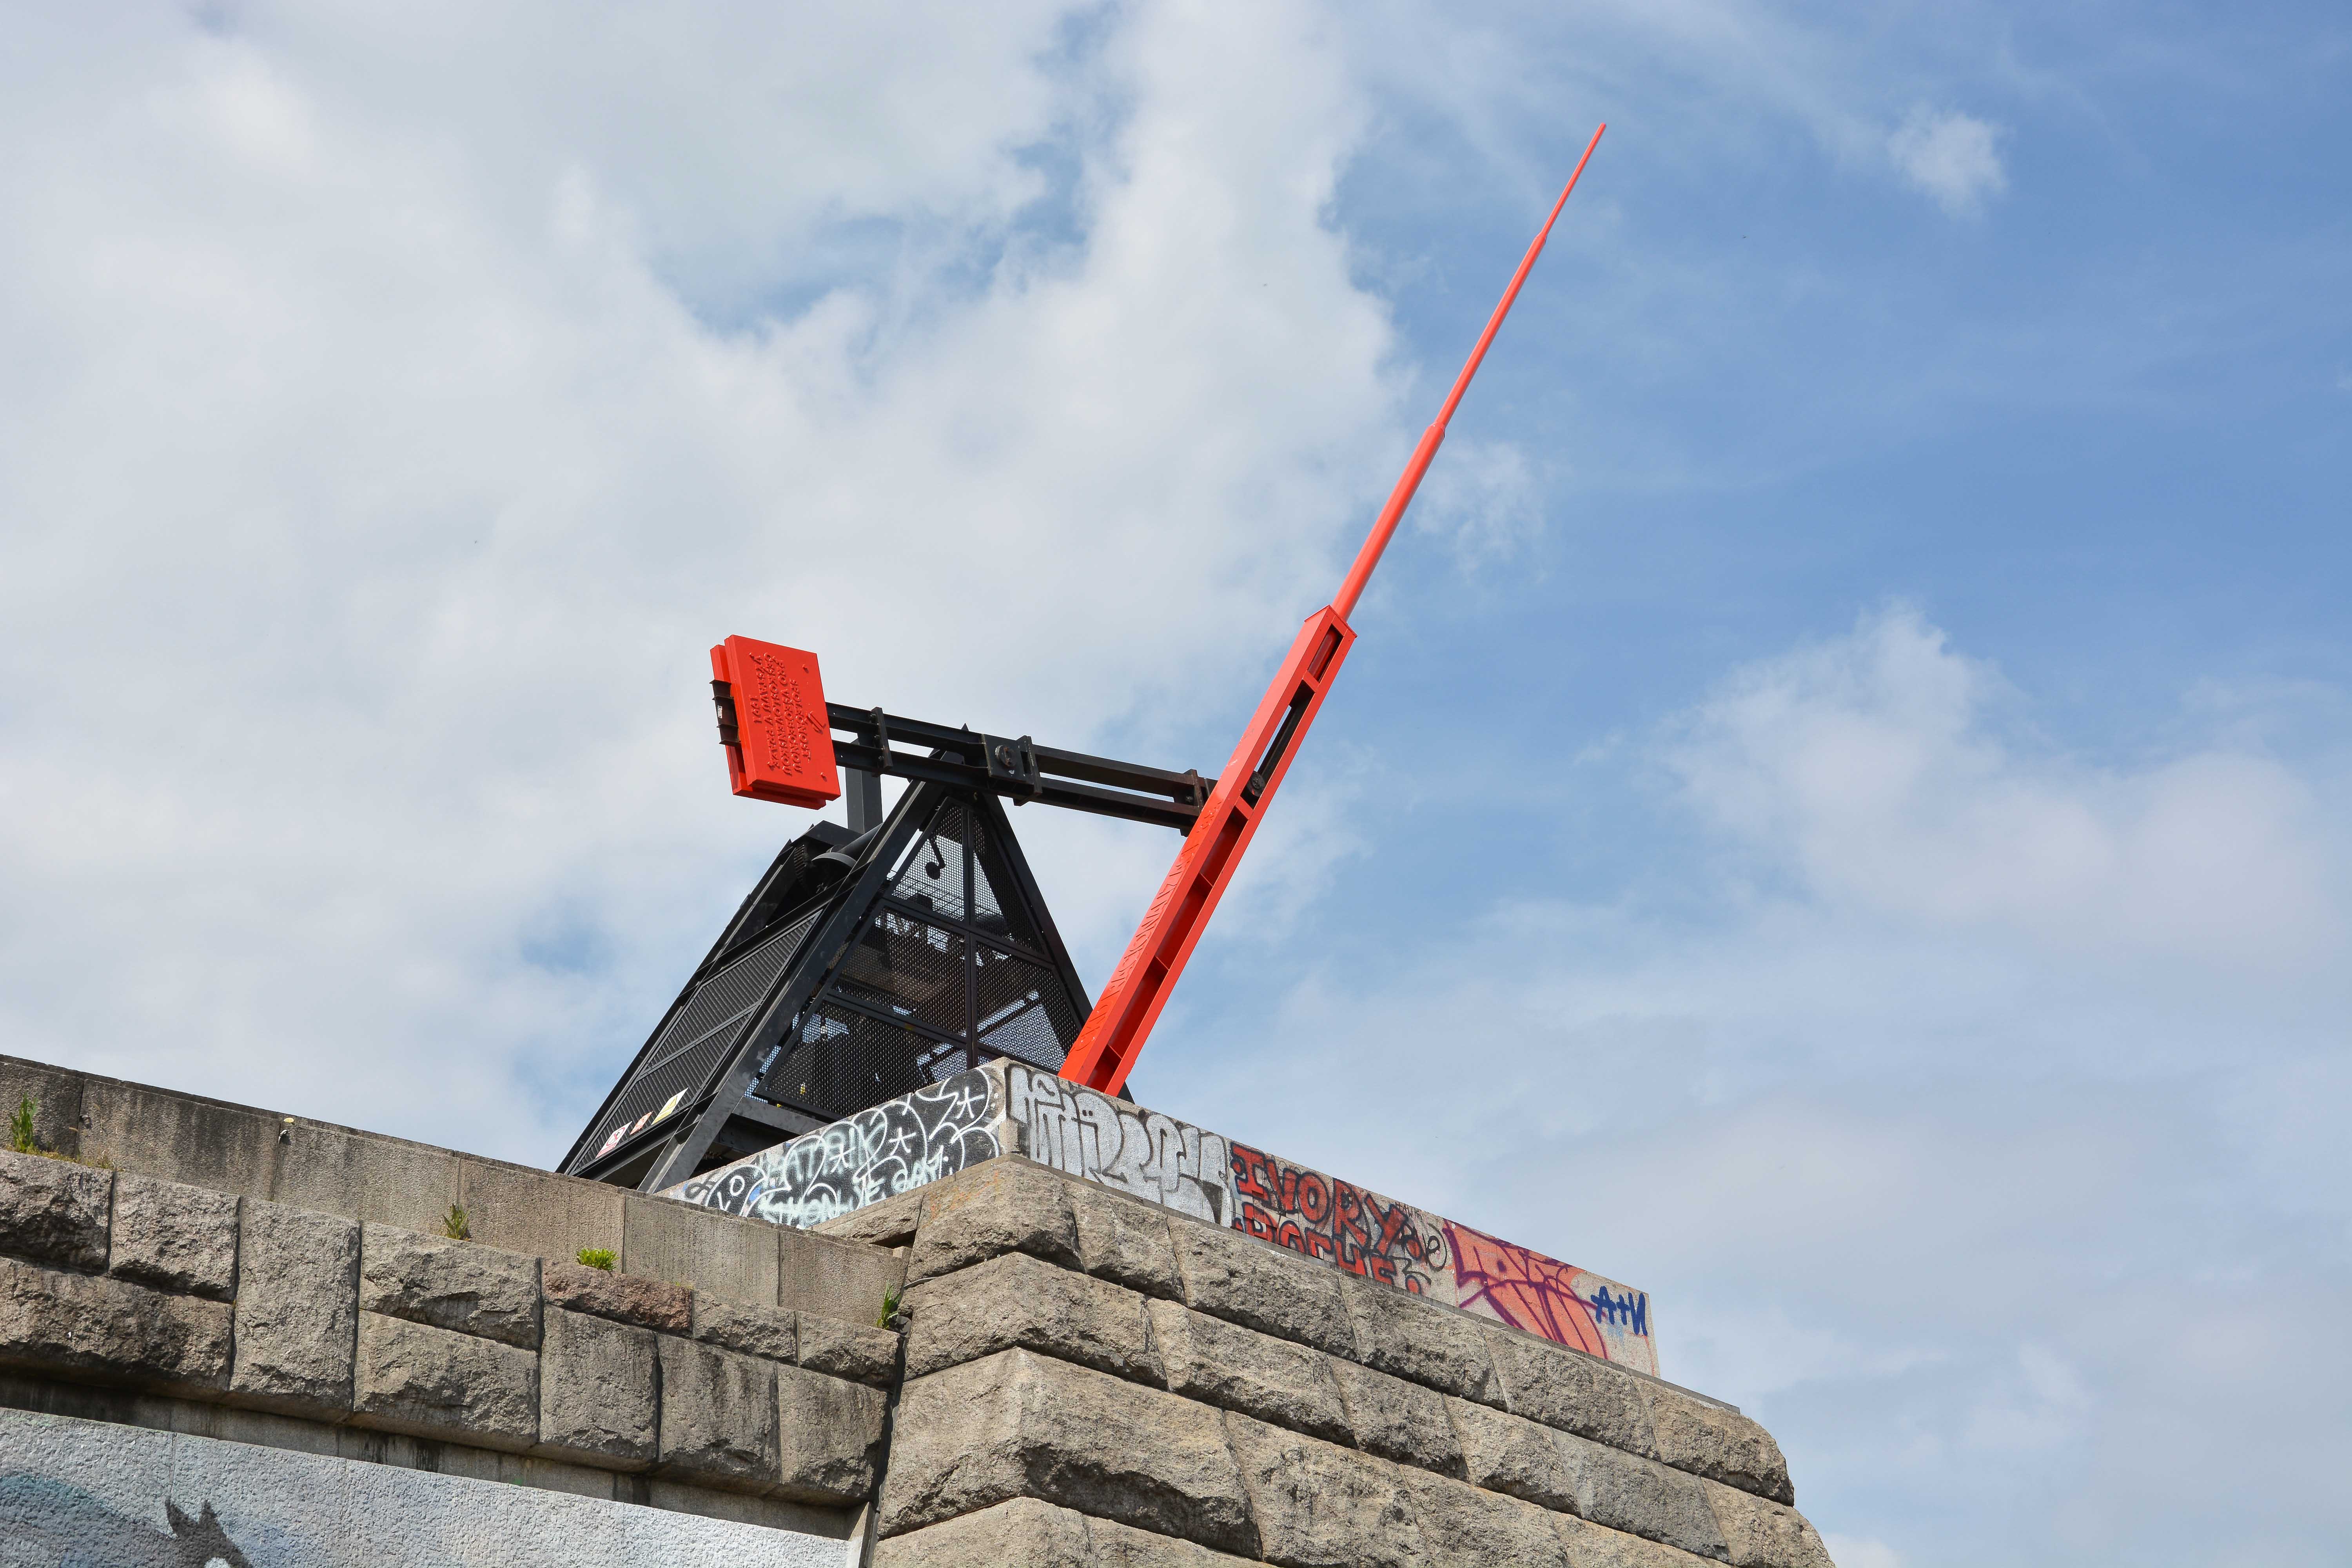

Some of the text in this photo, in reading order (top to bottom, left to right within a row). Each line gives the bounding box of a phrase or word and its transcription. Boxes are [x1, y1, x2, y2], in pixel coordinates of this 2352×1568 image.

[750, 697, 762, 724] 1991
[753, 655, 774, 713] VÝSTAVU
[765, 727, 781, 769] PRAZE
[764, 652, 793, 777] ČESKOSLOVENSKOU
[775, 659, 803, 774] PRO VŠEOBECNOU
[789, 678, 811, 762] SPOLEČNOST
